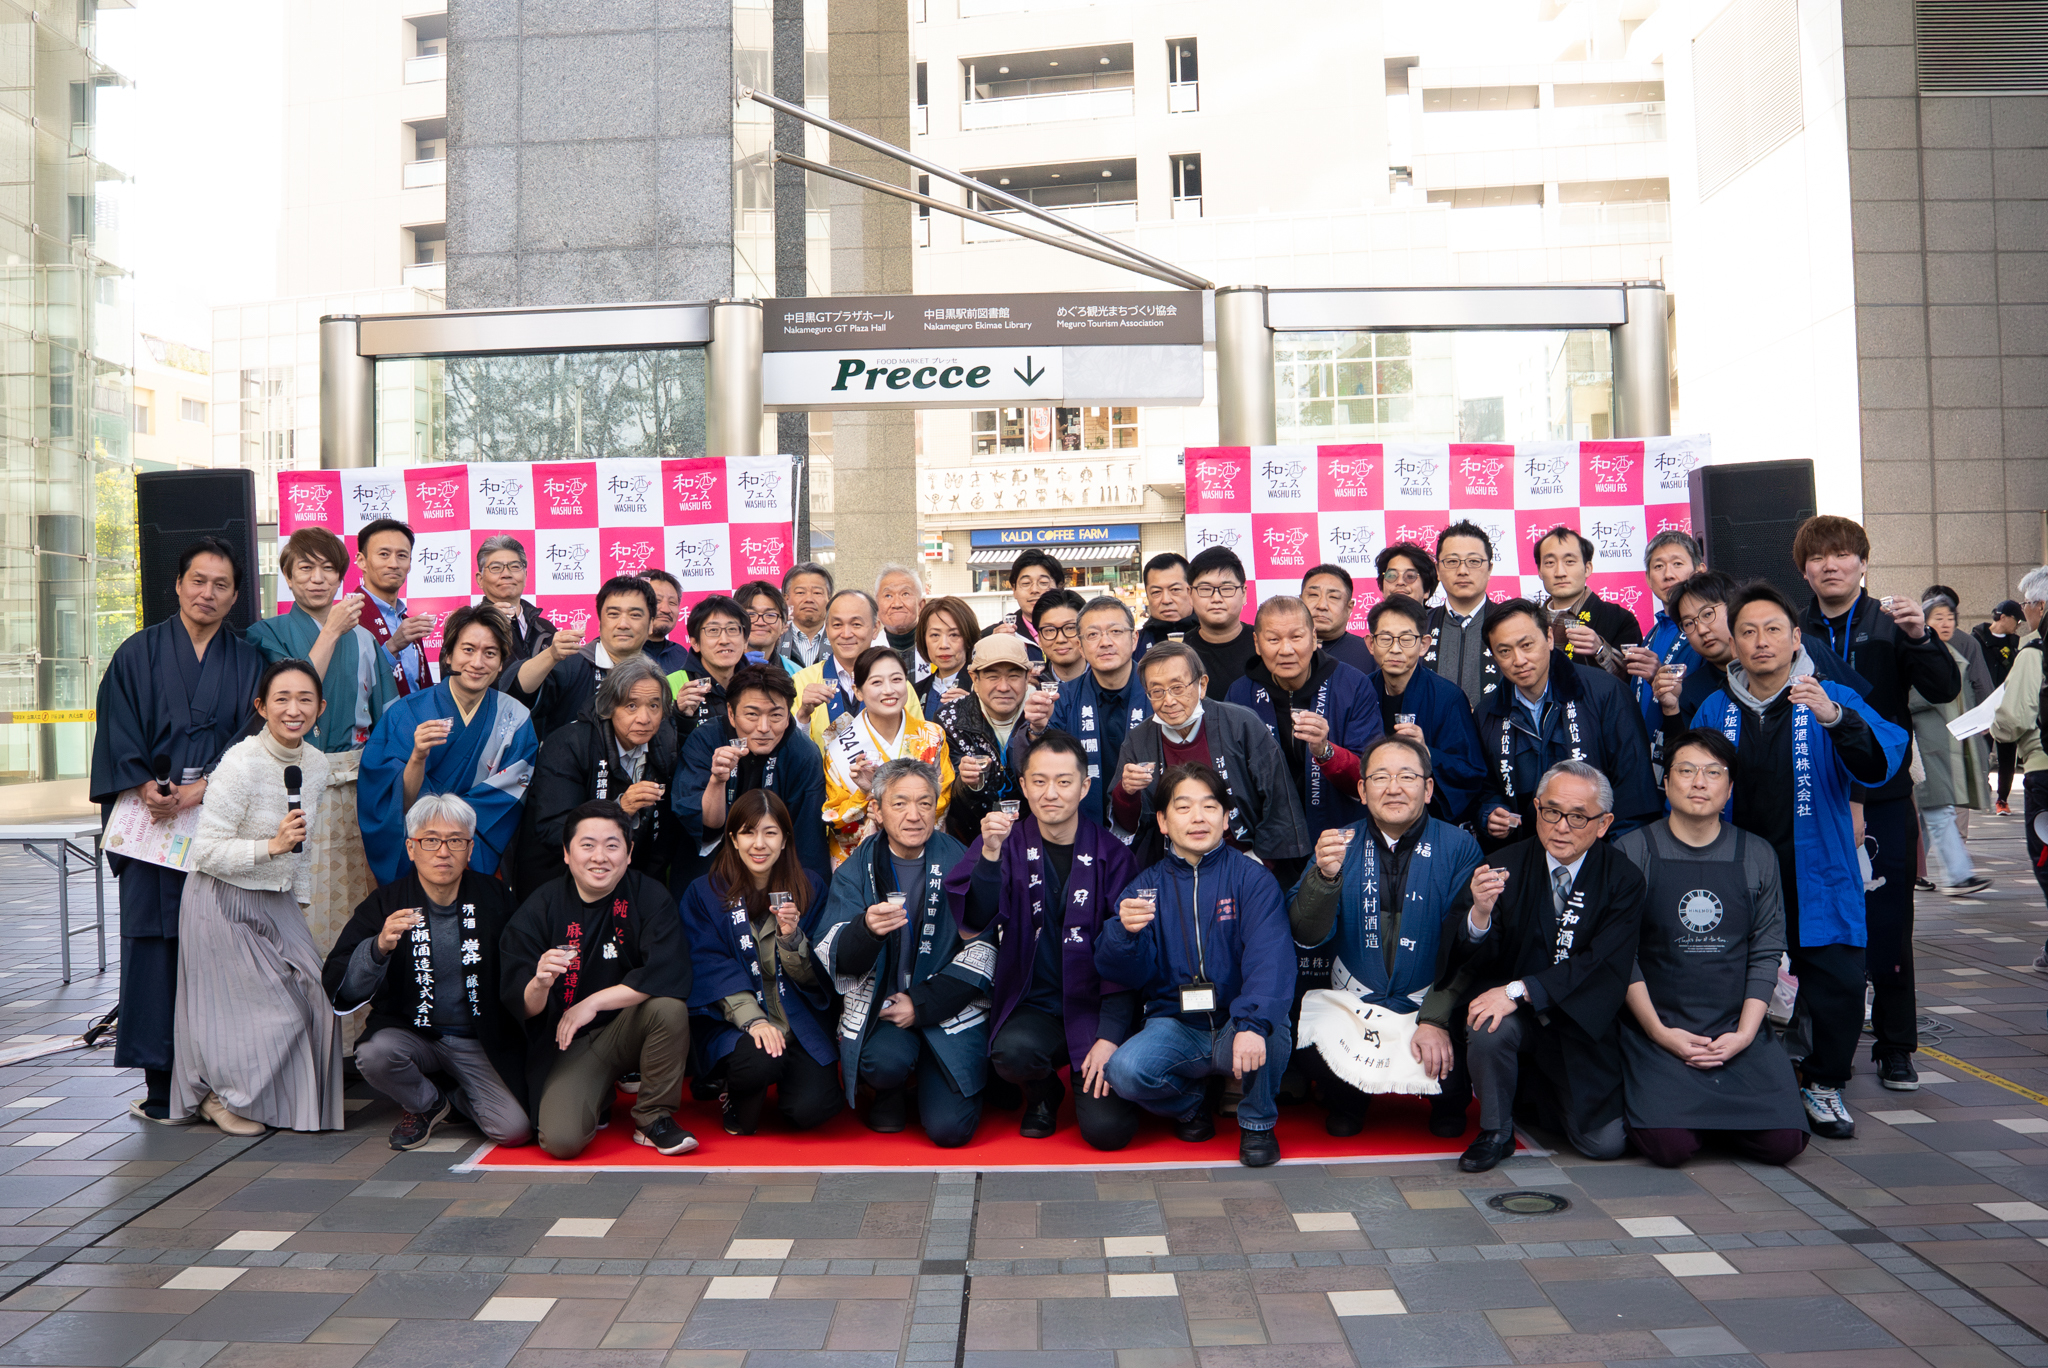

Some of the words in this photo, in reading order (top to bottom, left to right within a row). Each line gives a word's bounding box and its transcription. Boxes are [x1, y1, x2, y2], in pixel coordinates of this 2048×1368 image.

[924, 308, 1010, 320] 中目黒駅前図書館
[1057, 305, 1177, 317] めぐろ観光まちづくり協会
[784, 310, 894, 324] 中目黒GTプラザホール
[924, 322, 973, 331] Nakameguro
[975, 321, 1002, 329] Ekimae
[1004, 320, 1032, 330] Library
[1056, 320, 1086, 329] Meguro
[1087, 320, 1118, 328] Tourism
[1120, 319, 1164, 327] Association
[784, 326, 832, 335] Nakameguro
[850, 324, 868, 332] Plaza
[831, 359, 991, 391] Precce
[1336, 477, 1366, 487] フェス
[1402, 476, 1431, 486] フェス
[1467, 475, 1496, 485] フェス
[1533, 475, 1561, 485] フェス
[1597, 473, 1626, 483] フェス
[1204, 479, 1233, 490] フェス
[1270, 479, 1299, 488] フェス
[1595, 484, 1616, 492] WASHU
[1617, 483, 1628, 492] FES
[1660, 481, 1682, 490] WASHU
[681, 490, 710, 500] フェス
[746, 489, 775, 499] フェス
[1201, 491, 1222, 499] WASHU
[1224, 490, 1235, 499] FES
[1268, 490, 1289, 498] WASHU
[1291, 489, 1301, 498] FES
[1334, 489, 1355, 497] WASHU
[1357, 488, 1368, 497] FES
[1400, 487, 1421, 496] WASHU
[1422, 487, 1433, 496] FES
[1465, 486, 1487, 495] WASHU
[1488, 486, 1498, 496] FES
[1530, 486, 1551, 495] WASHU
[1553, 485, 1564, 494] FES
[488, 496, 516, 506] フェス
[552, 496, 581, 505] フェス
[616, 493, 645, 503] フェス
[297, 502, 325, 512] フェス
[361, 502, 390, 512] フェス
[424, 499, 452, 509] フェス
[614, 504, 635, 512] WASHU
[637, 504, 647, 512] FES
[679, 502, 700, 511] WASHU
[701, 501, 712, 510] FES
[744, 500, 765, 508] WASHU
[767, 500, 777, 508] FES
[423, 510, 443, 519] WASHU
[444, 509, 454, 518] FES
[486, 507, 507, 515] WASHU
[508, 507, 518, 515] FES
[550, 507, 571, 516] WASHU
[573, 506, 583, 515] FES
[294, 513, 315, 522] WASHU
[317, 513, 328, 521] FES
[1001, 531, 1032, 542] KALDI
[1037, 530, 1075, 540] COFFEE
[1079, 528, 1109, 539] FARM
[1600, 539, 1629, 548] フェス
[1271, 546, 1301, 555] フェス
[1338, 544, 1368, 554] フェス
[1599, 549, 1620, 558] WASHU
[1622, 549, 1632, 558] FES
[683, 557, 712, 567] フェス
[748, 555, 777, 565] フェス
[1270, 557, 1292, 566] WASHU
[1293, 556, 1304, 565] FES
[1337, 555, 1358, 563] WASHU
[1360, 554, 1371, 563] FES
[425, 564, 453, 574] フェス
[554, 561, 582, 571] フェス
[618, 560, 647, 569] フェス
[682, 568, 703, 577] WASHU
[704, 568, 715, 576] FES
[747, 566, 768, 575] WASHU
[769, 566, 780, 575] FES
[423, 575, 443, 583] WASHU
[445, 574, 455, 583] FES
[552, 572, 572, 580] WASHU
[574, 572, 584, 580] FES
[1081, 705, 1095, 731] 美酒
[1364, 840, 1375, 876] 秋田湯沢
[1400, 842, 1432, 951] 福小町
[462, 904, 476, 929] 清酒
[1362, 879, 1379, 949] 木村酒造
